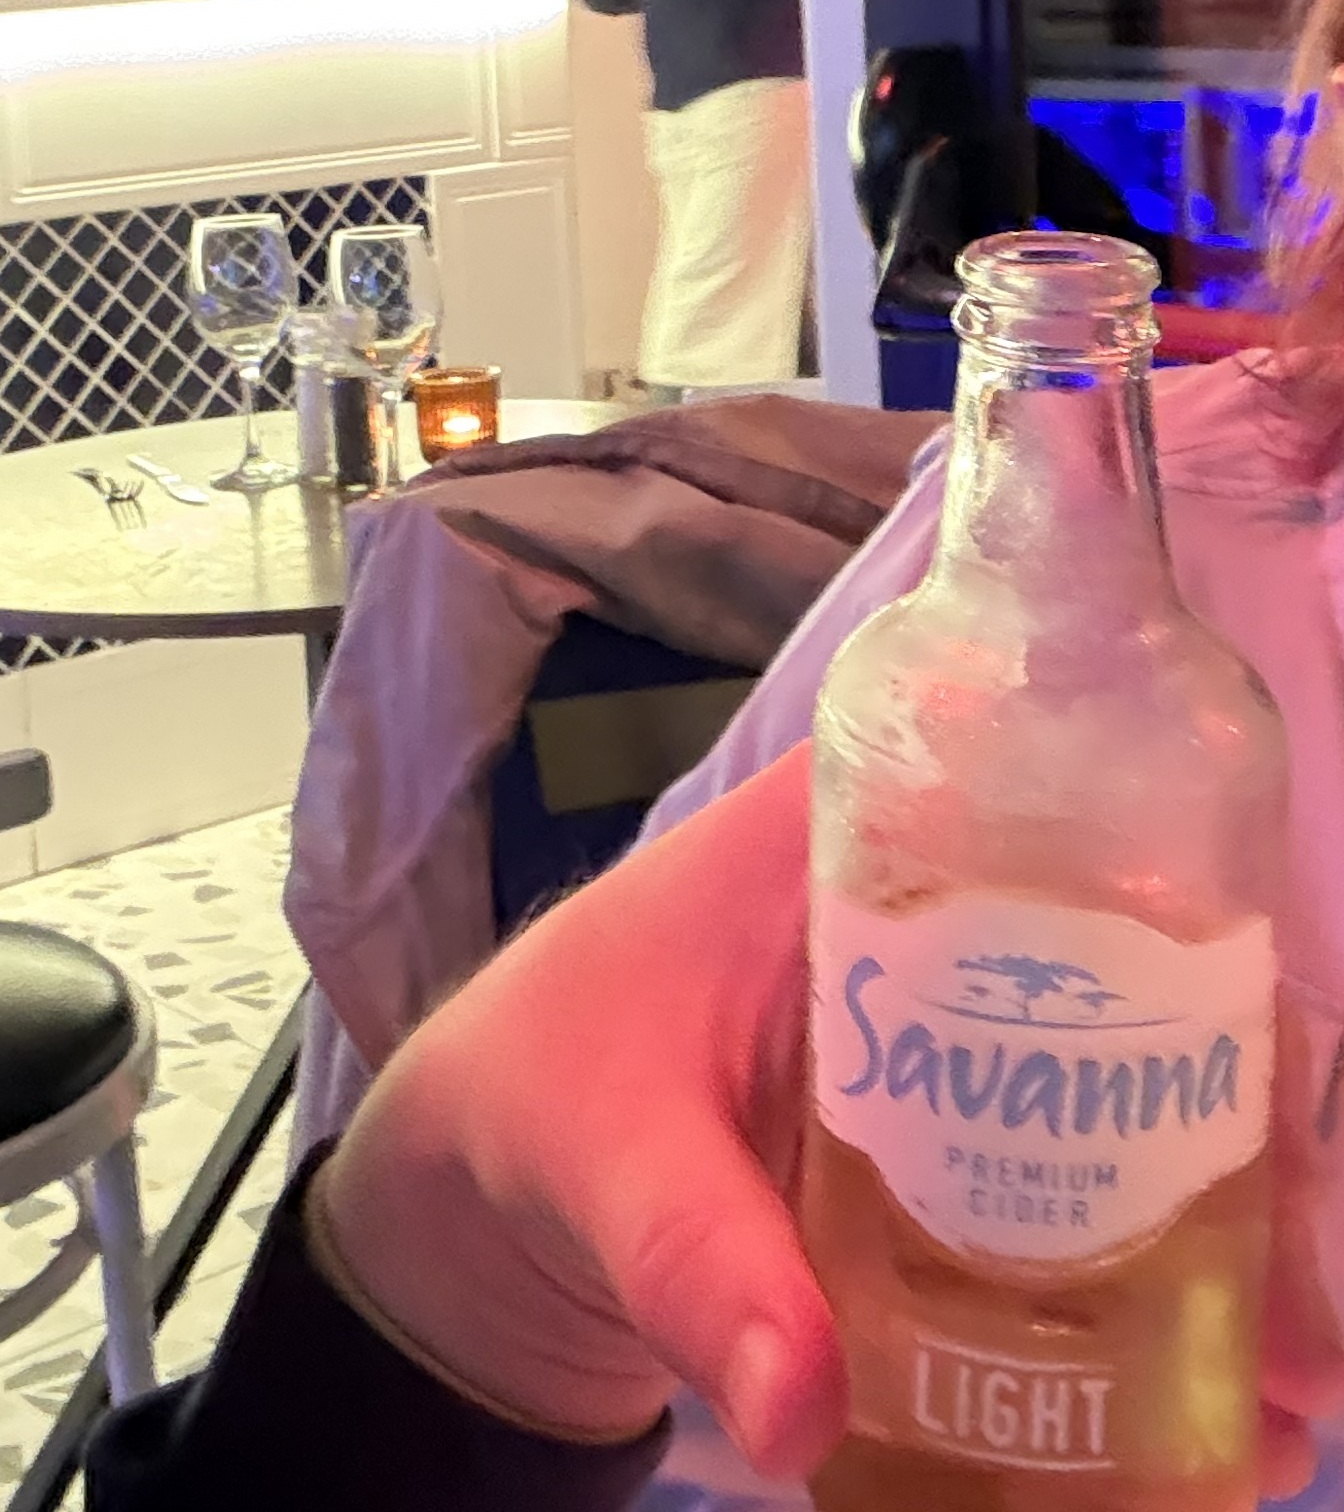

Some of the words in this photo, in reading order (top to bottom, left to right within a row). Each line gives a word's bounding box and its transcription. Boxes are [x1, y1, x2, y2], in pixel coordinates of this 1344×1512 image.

[839, 956, 1240, 1139] Savanna
[944, 1145, 1121, 1189] PREMIUM
[969, 1189, 1091, 1228] CIDER
[912, 1349, 1116, 1455] LIGHT
